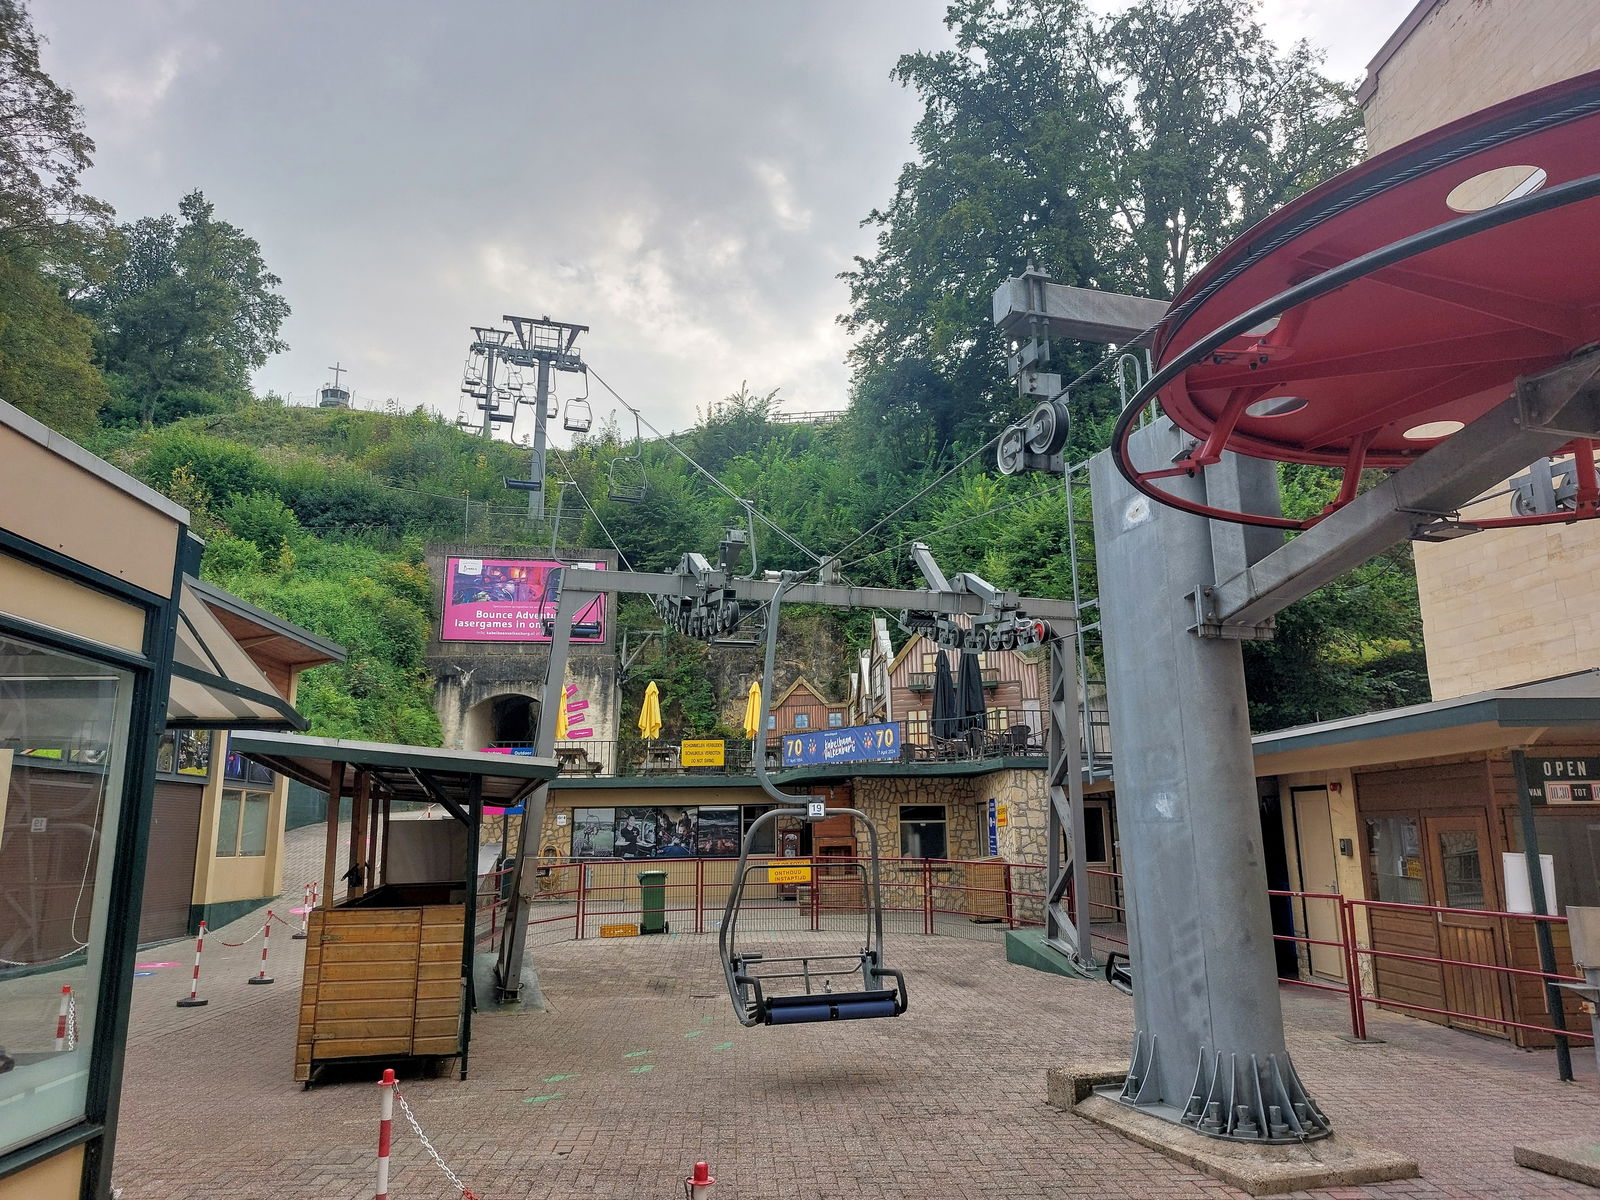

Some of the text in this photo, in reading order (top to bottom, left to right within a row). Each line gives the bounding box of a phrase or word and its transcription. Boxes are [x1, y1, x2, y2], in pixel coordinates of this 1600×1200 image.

[476, 610, 513, 619] Bounce
[455, 619, 513, 629] lasergames
[516, 620, 526, 628] in
[876, 728, 894, 748] 70
[787, 739, 803, 757] 70
[1543, 761, 1587, 776] OPEN
[1528, 788, 1542, 797] VAN
[1573, 788, 1587, 797] TOT
[812, 804, 822, 813] 19
